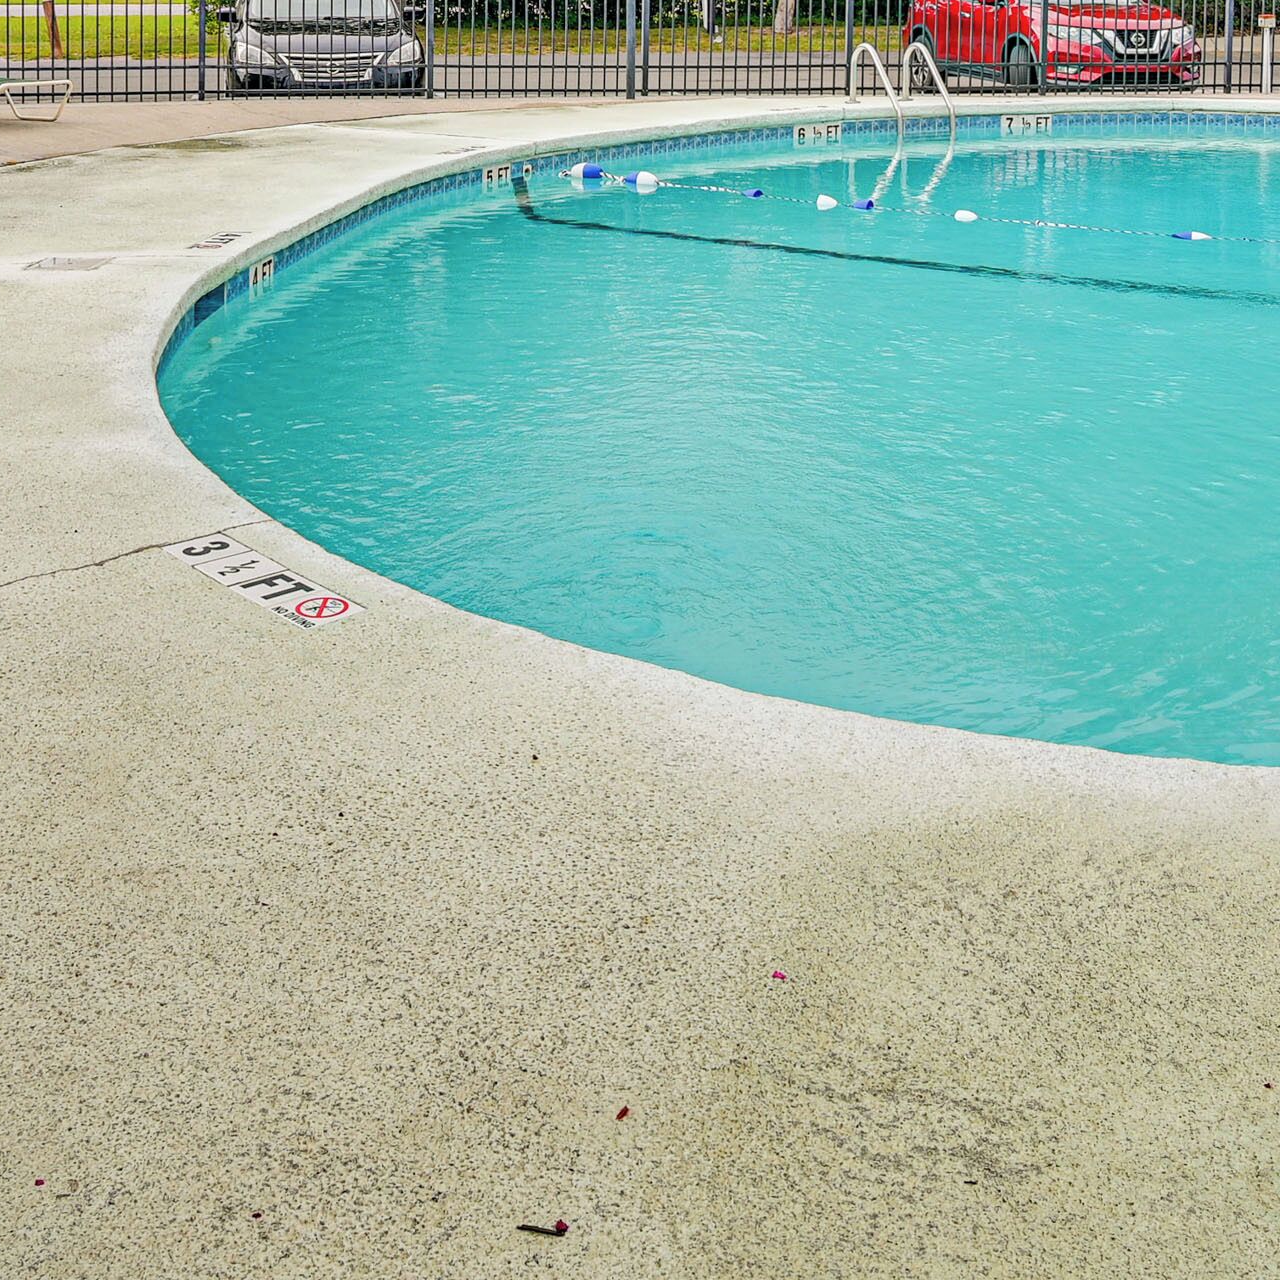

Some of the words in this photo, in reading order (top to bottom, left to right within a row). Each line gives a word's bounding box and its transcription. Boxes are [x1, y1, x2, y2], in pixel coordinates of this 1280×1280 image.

[826, 125, 839, 139] FT
[1036, 116, 1050, 131] FT
[182, 541, 231, 557] 3
[239, 573, 315, 601] FT
[271, 606, 289, 615] NO
[283, 612, 316, 629] DIVING
